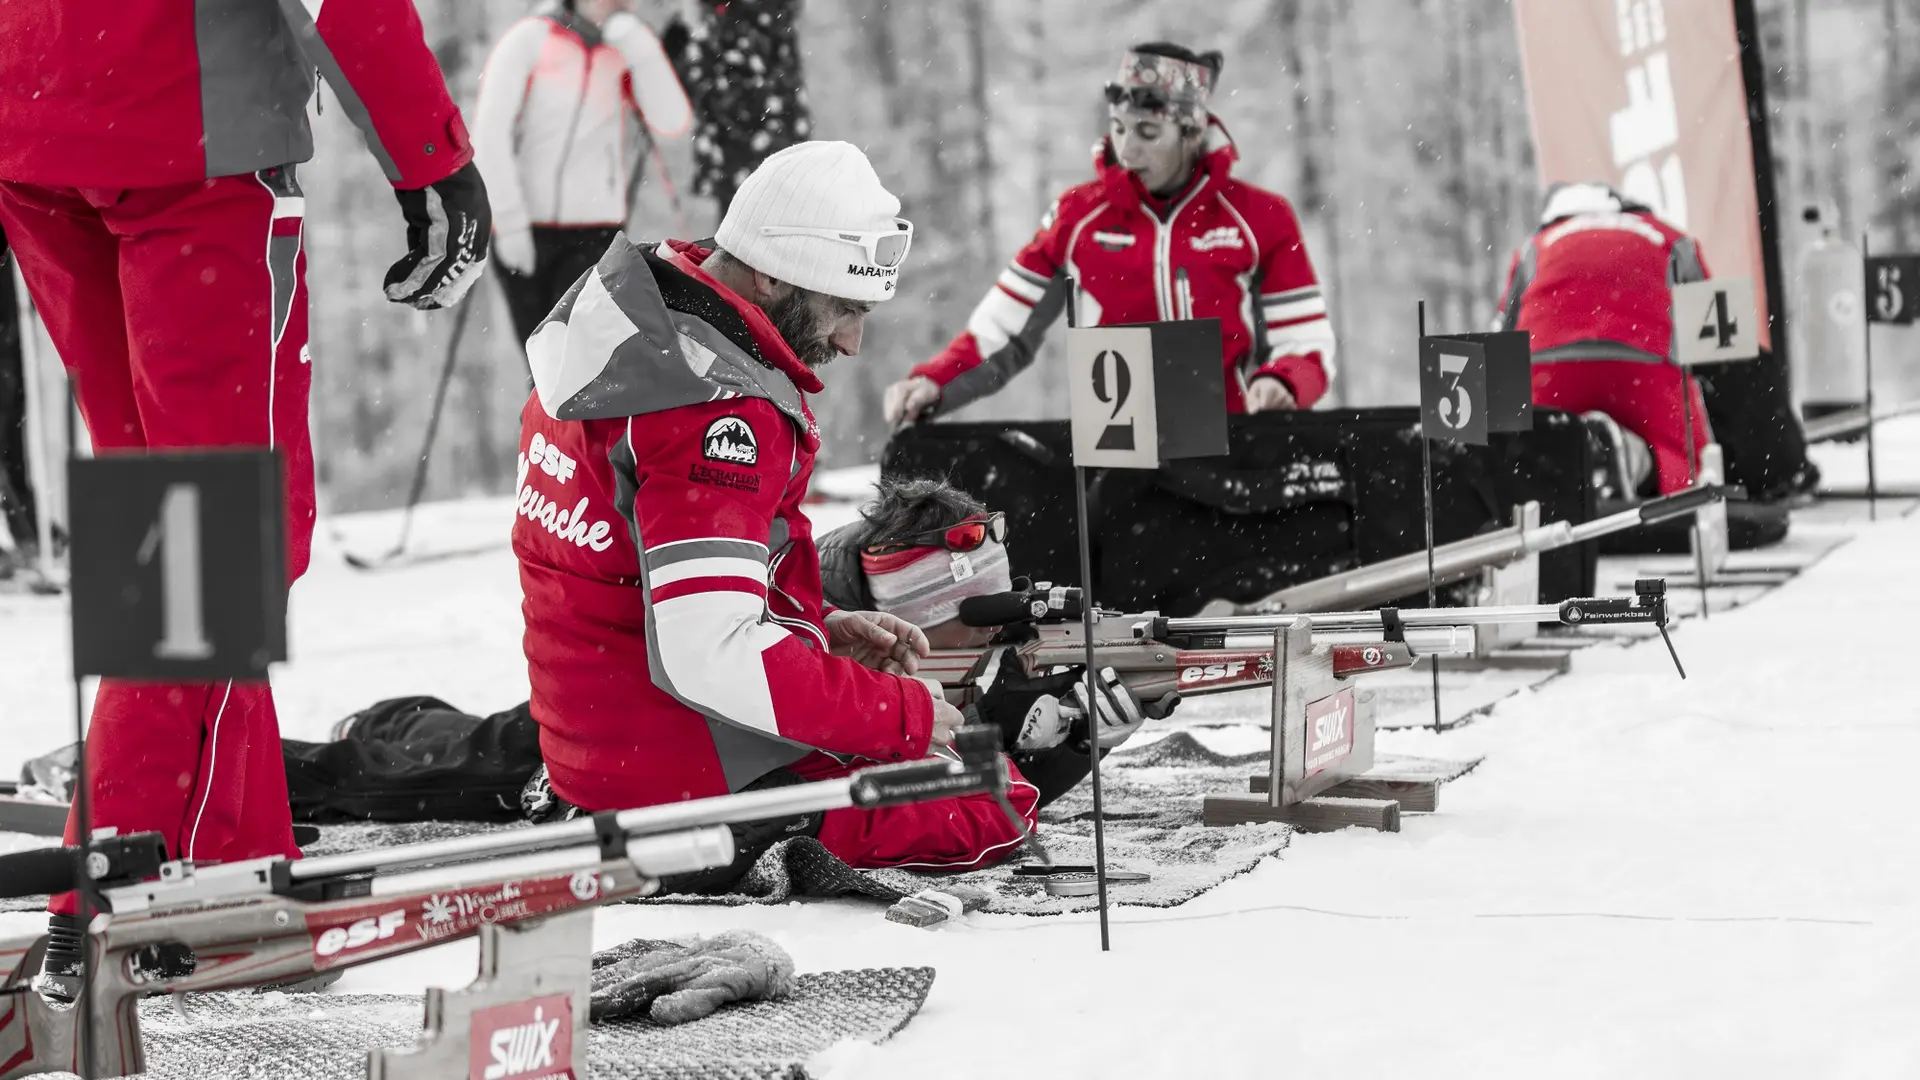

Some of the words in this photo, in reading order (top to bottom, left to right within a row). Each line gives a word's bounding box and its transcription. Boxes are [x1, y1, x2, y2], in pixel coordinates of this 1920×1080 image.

[1698, 290, 1738, 348] 4
[1877, 264, 1904, 320] 5
[1092, 350, 1135, 450] 2
[1439, 353, 1472, 429] 3
[137, 481, 217, 660] 1
[1584, 611, 1653, 619] Feinwerkbau
